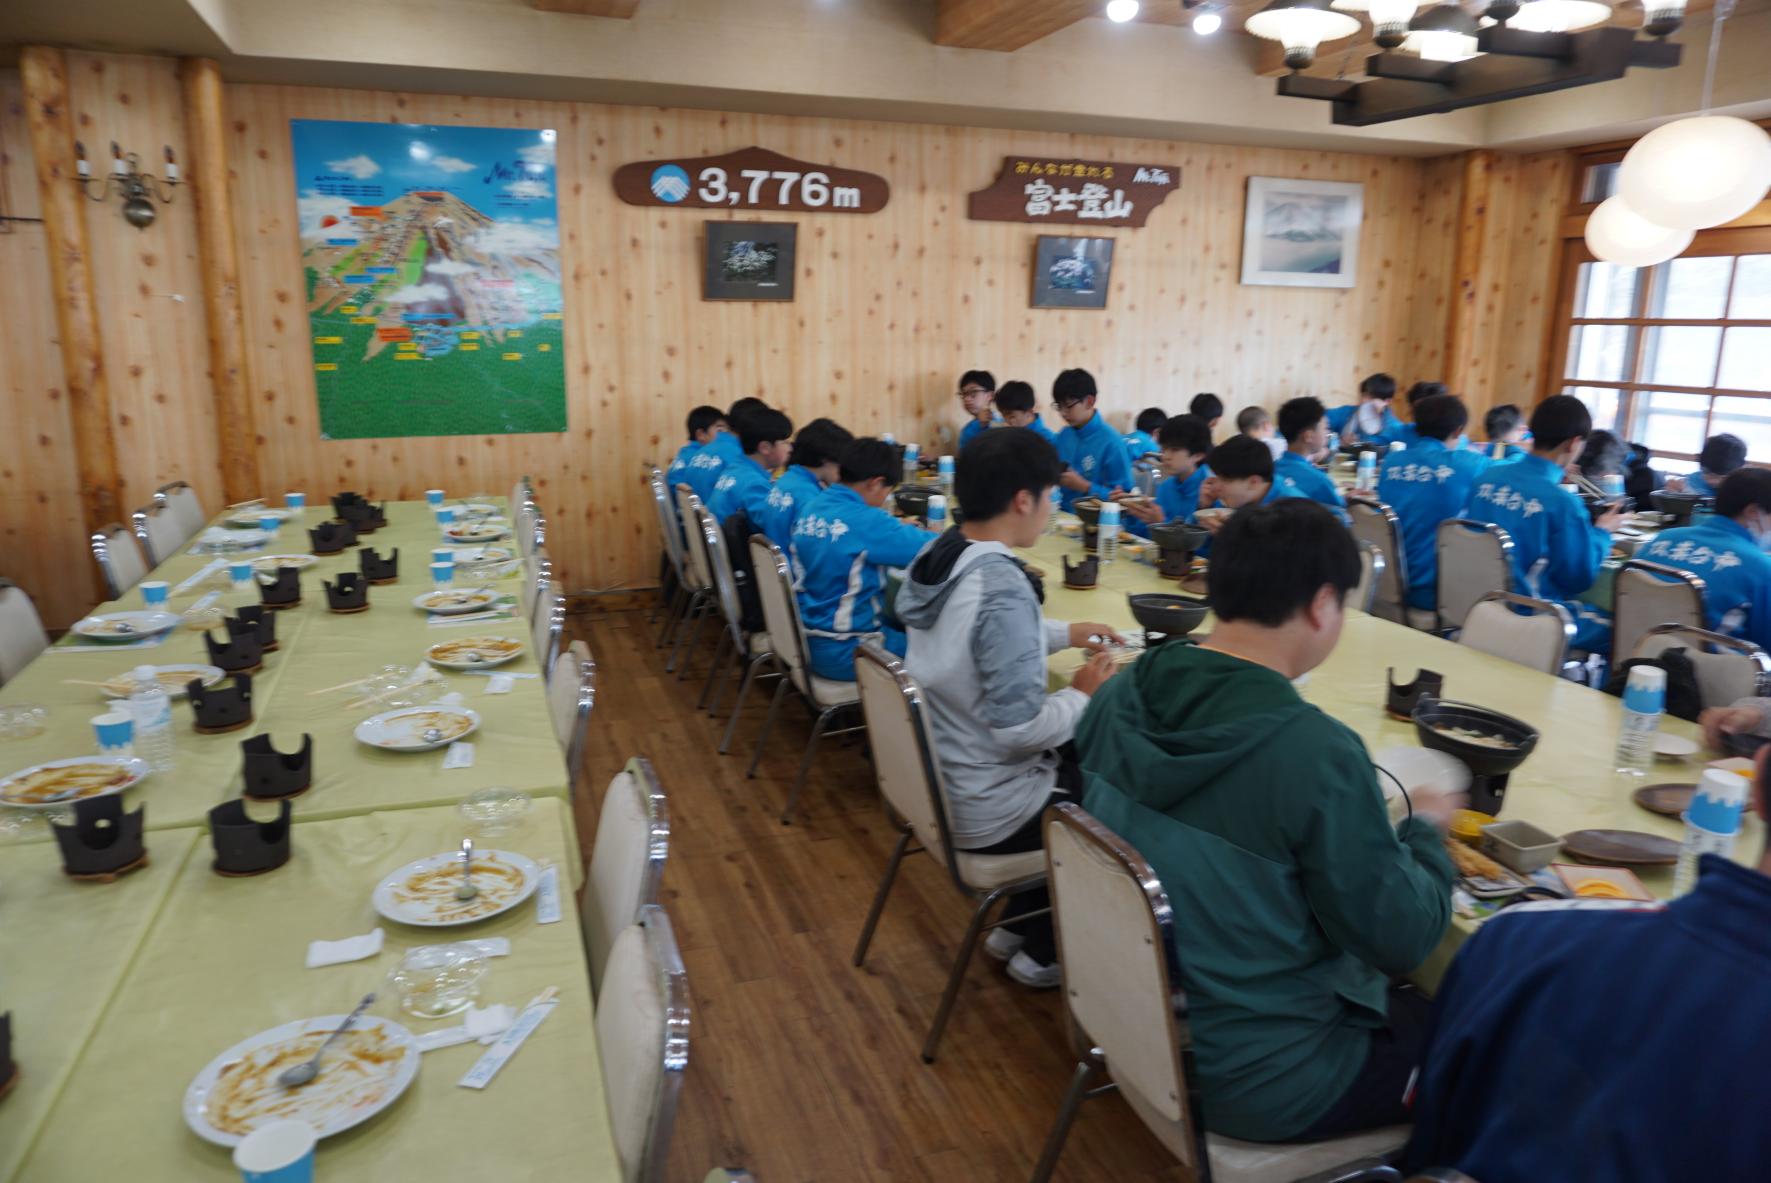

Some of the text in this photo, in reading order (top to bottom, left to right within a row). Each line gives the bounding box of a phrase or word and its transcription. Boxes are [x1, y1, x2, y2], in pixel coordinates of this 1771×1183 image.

[697, 166, 861, 208] 3,776m
[1024, 178, 1134, 220] 富士登山
